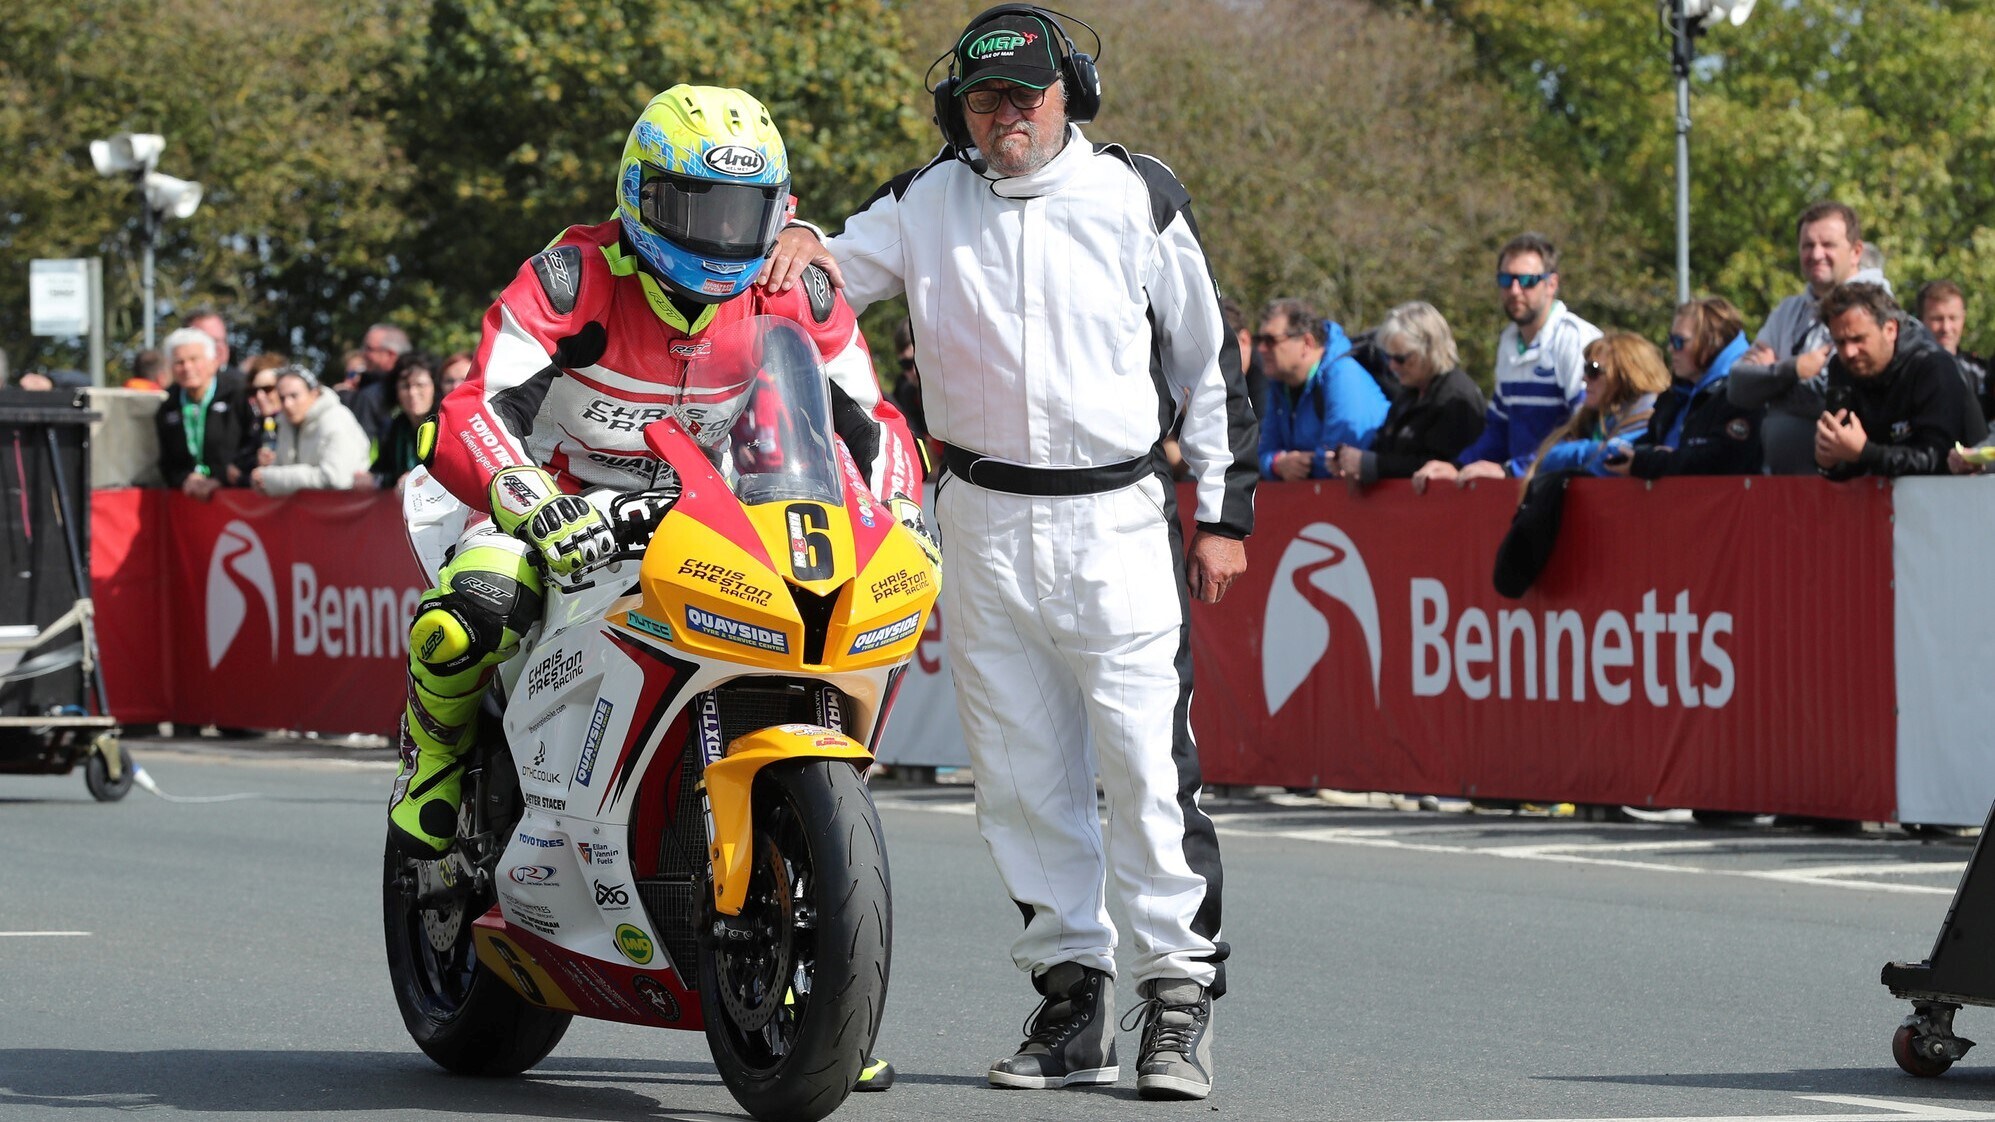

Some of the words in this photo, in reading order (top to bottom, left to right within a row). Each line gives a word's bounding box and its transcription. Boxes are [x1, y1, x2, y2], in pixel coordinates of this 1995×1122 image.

[977, 36, 1026, 55] MGP
[709, 148, 759, 168] Arai
[549, 250, 574, 297] RST
[670, 342, 712, 357] RST
[591, 400, 708, 420] CHRS
[467, 413, 499, 447] TOYO
[489, 444, 515, 467] TIR
[504, 475, 540, 499] RST
[785, 503, 834, 581] 6
[684, 559, 746, 580] CHRIS
[871, 569, 908, 594] CHRIS
[460, 576, 514, 598] RST
[678, 566, 773, 600] PRESTON
[873, 571, 927, 604] PRESTON
[905, 580, 929, 596] RACING
[720, 586, 767, 607] RACING
[292, 562, 422, 659] Benne
[688, 608, 785, 647] QUAYSIDE
[702, 626, 720, 637] TYRE
[728, 634, 757, 646] SERVICE
[759, 642, 785, 652] CENTRE
[854, 612, 920, 649] QUAYSIDE
[421, 625, 445, 660] RST
[1410, 577, 1735, 708] Bennetts
[528, 648, 563, 685] CHRIS
[528, 650, 583, 700] PRESTON
[552, 665, 584, 692] RACING
[827, 691, 843, 734] MAX
[577, 701, 608, 781] QUAYSIDE
[525, 792, 541, 806] PETER
[542, 797, 566, 811] STACEY
[520, 833, 536, 846] TOYO
[536, 838, 564, 848] TIRES
[594, 849, 619, 858] Vannin
[596, 857, 613, 865] Fuels
